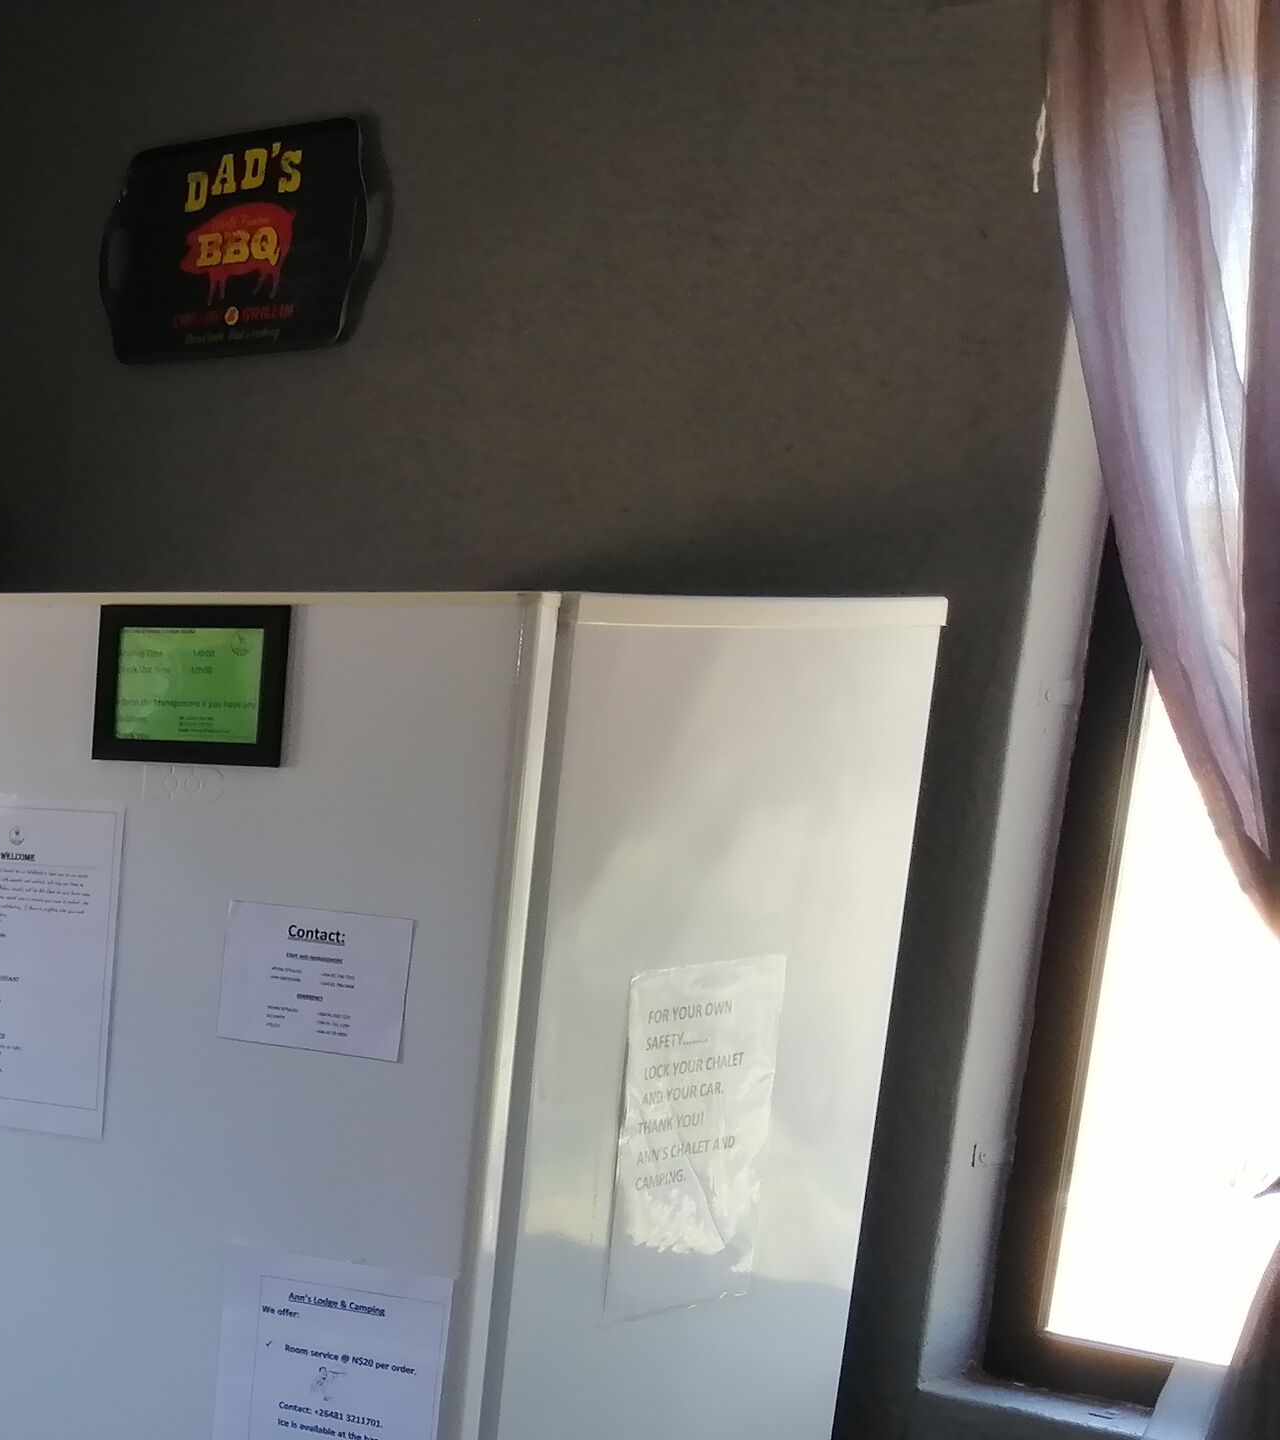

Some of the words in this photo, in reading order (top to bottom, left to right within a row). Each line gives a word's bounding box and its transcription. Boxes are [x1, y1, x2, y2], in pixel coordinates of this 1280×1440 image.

[184, 142, 302, 213] DAD'S
[196, 226, 281, 267] BBQ
[0, 851, 35, 862] WELCOME
[288, 924, 345, 944] Contact:
[648, 1009, 669, 1024] FOR
[672, 1004, 702, 1022] YOUR
[705, 1000, 732, 1016] OWN
[644, 1063, 670, 1081] LOCK
[672, 1058, 703, 1076] YOUR
[705, 1052, 745, 1071] CHALET
[642, 1090, 663, 1105] AND
[666, 1085, 697, 1102] YOUR
[700, 1082, 724, 1097] CAR.
[638, 1117, 673, 1136] THANK
[676, 1112, 704, 1129] YOU!
[670, 1139, 710, 1158] CHALET
[712, 1135, 736, 1151] AND
[635, 1169, 687, 1191] CAMPING.
[262, 1305, 275, 1315] We
[288, 1292, 312, 1303] Ann's
[313, 1296, 338, 1309] Lodge
[340, 1300, 347, 1309] &
[349, 1302, 386, 1317] Camping
[284, 1344, 308, 1355] Room
[310, 1348, 339, 1361] service
[340, 1354, 350, 1363] @
[352, 1356, 374, 1368] N$20
[375, 1361, 389, 1370] per
[391, 1363, 417, 1376] order.
[278, 1401, 312, 1415] Contact:
[278, 1418, 290, 1428] Ice
[291, 1420, 298, 1429] is
[299, 1422, 336, 1437] available
[337, 1430, 346, 1439] at
